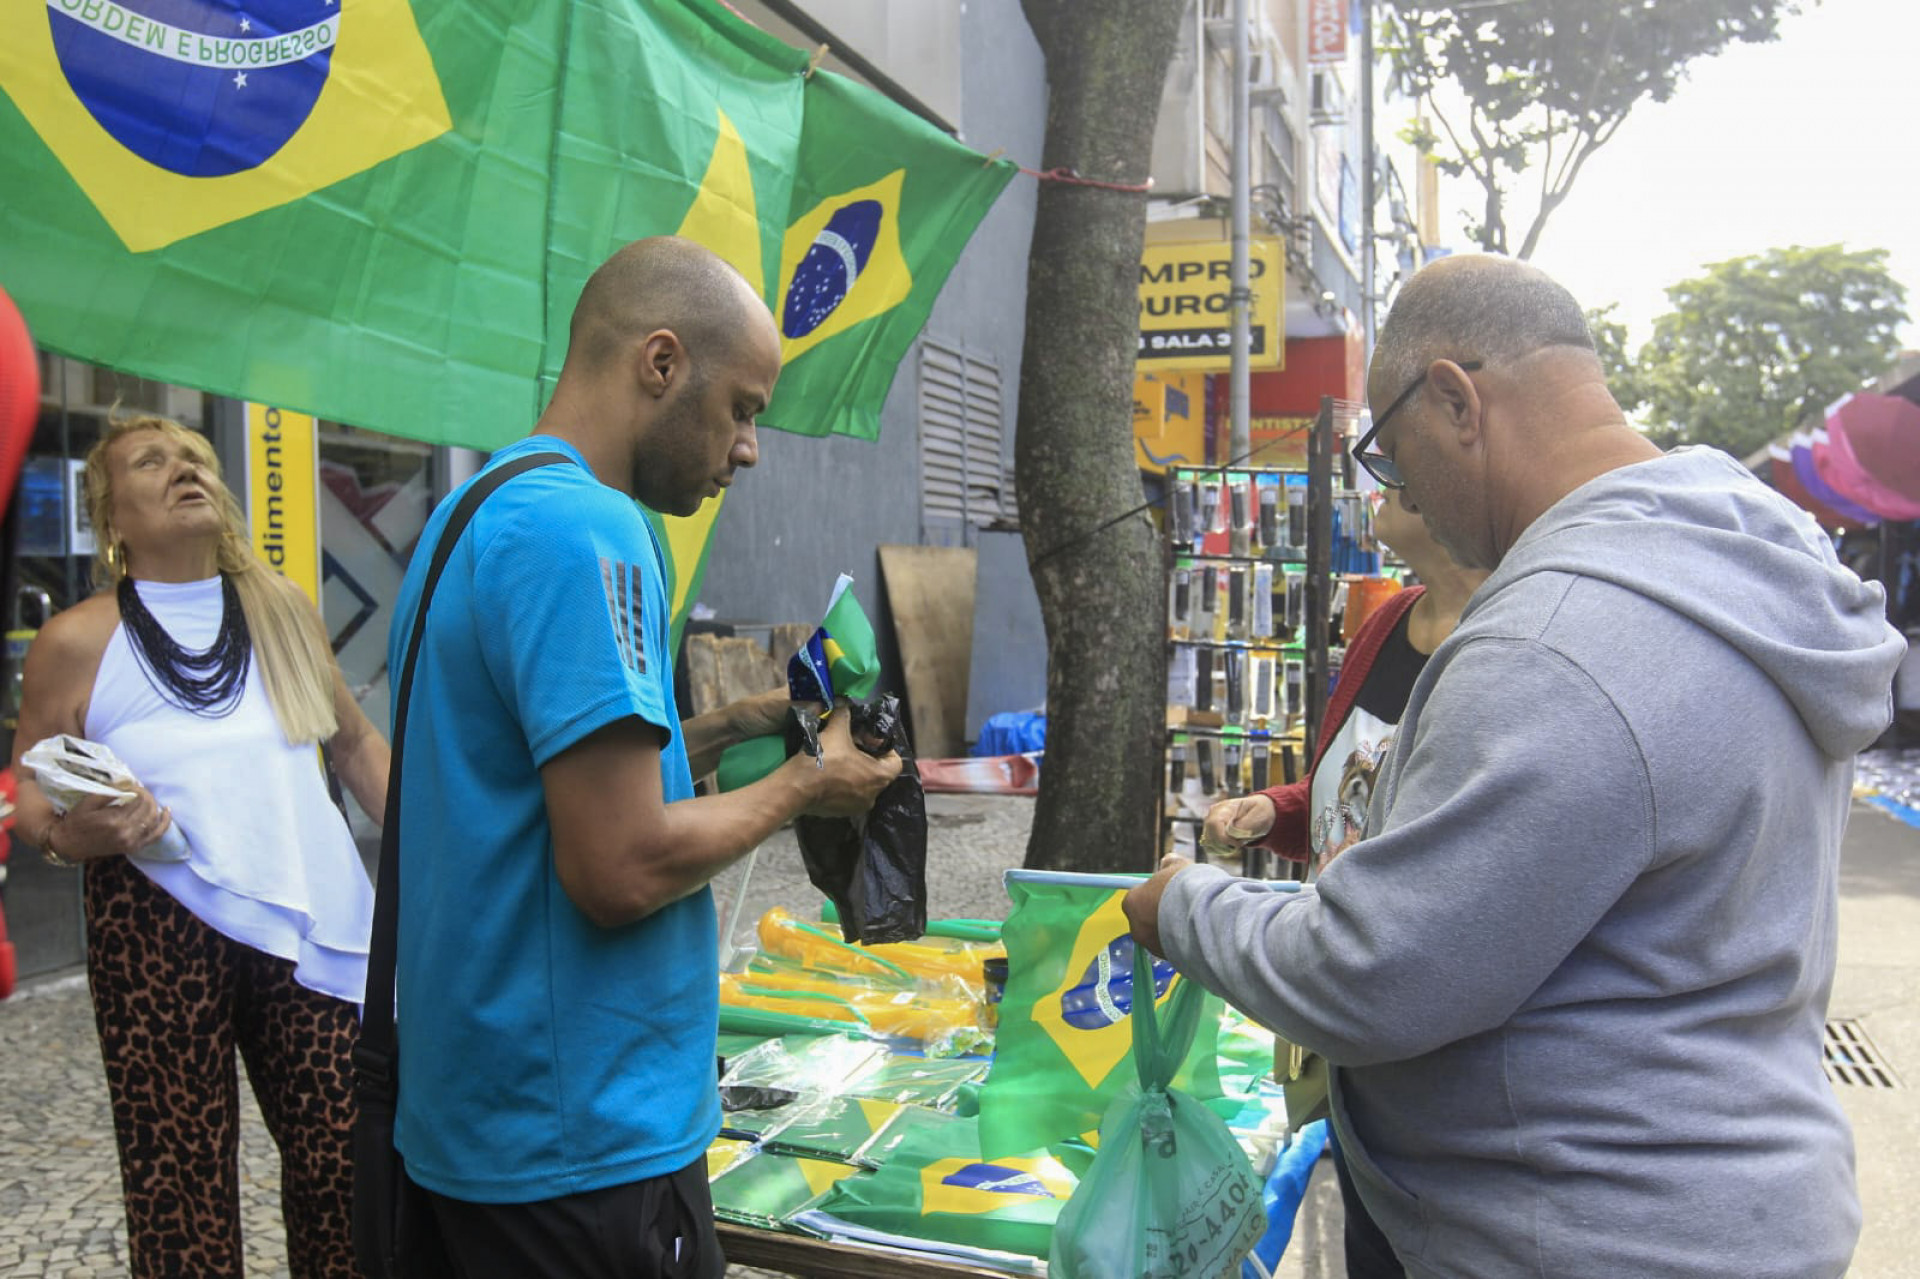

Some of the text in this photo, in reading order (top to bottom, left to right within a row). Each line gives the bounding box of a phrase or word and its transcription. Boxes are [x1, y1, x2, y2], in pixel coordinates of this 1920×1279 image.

[1140, 292, 1234, 317] URO
[1150, 333, 1215, 349] SALA
[261, 407, 286, 576] dimento
